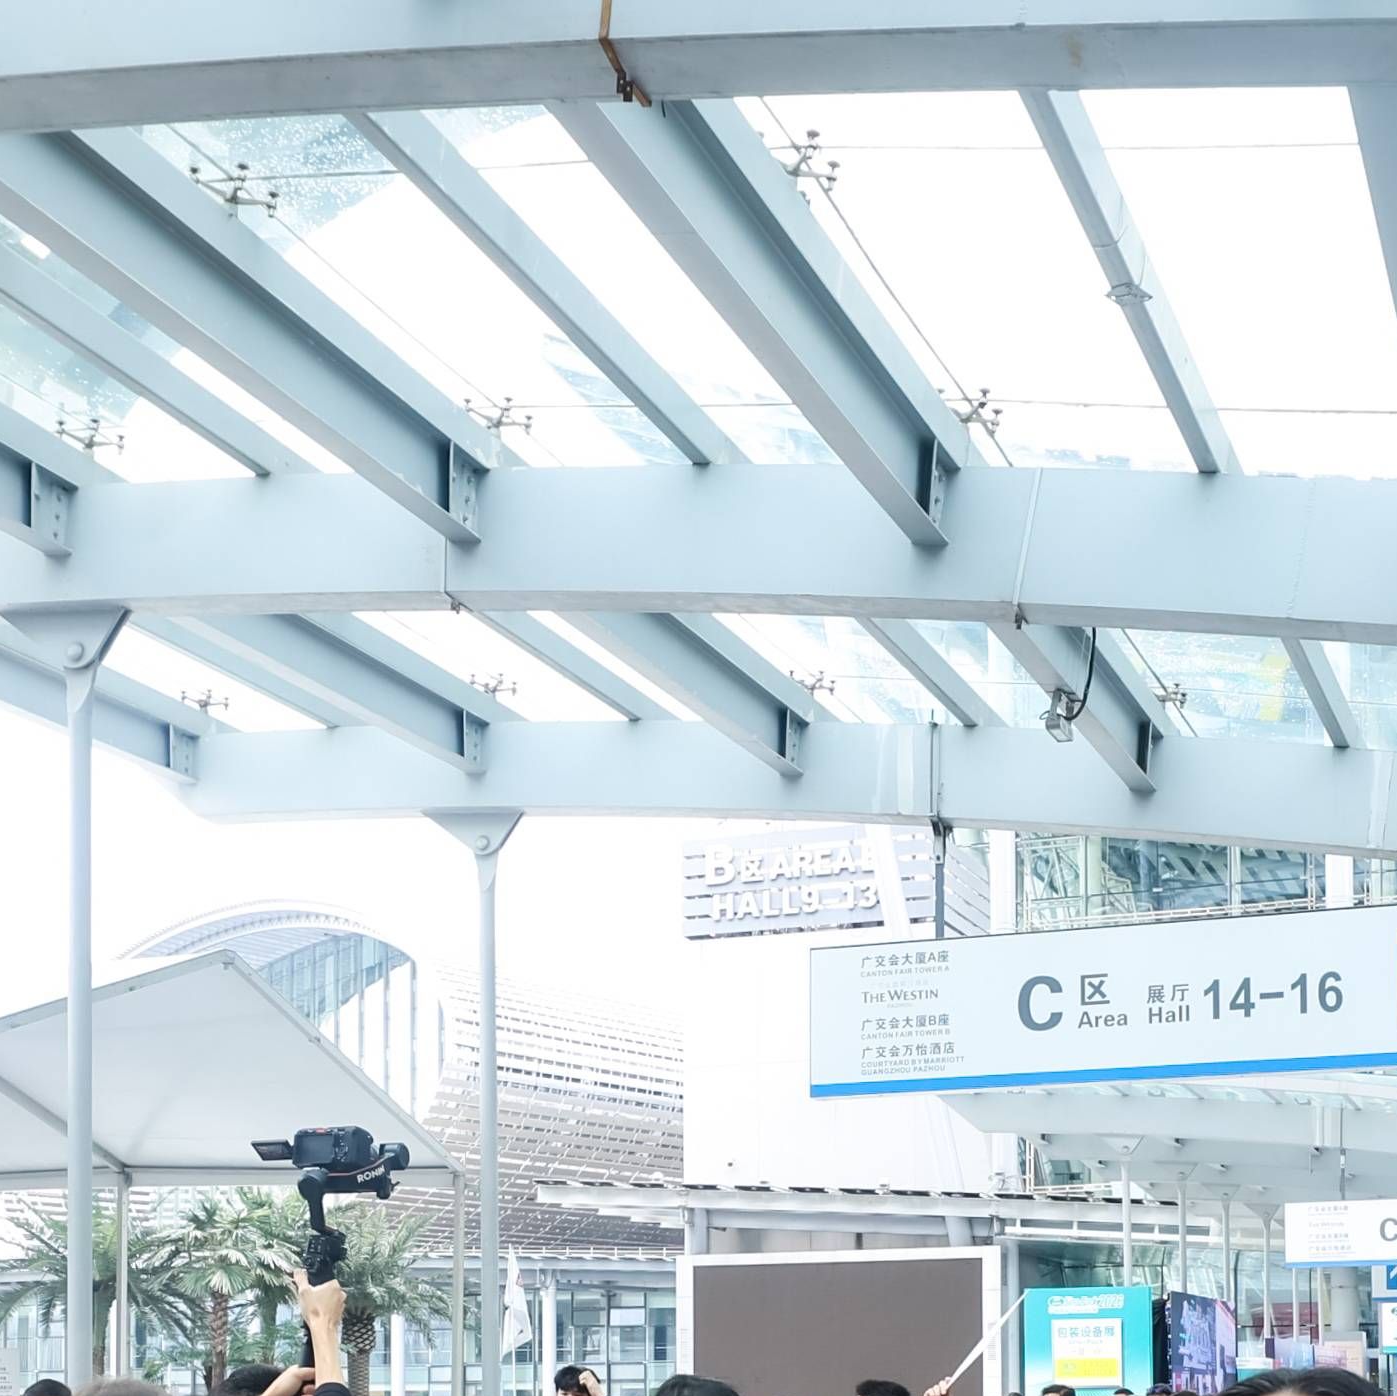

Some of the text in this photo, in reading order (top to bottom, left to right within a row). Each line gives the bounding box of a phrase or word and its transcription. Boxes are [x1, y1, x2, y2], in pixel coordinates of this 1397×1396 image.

[711, 885, 800, 921] HALL
[861, 950, 949, 968] 广交会大厦A座
[1080, 973, 1111, 1006] 区
[1146, 983, 1190, 1005] 展厅
[1203, 971, 1344, 1020] 14-16
[1017, 975, 1063, 1032] C
[861, 1013, 950, 1031] 广交会大厦B座
[1077, 1010, 1129, 1029] Area
[1147, 1004, 1191, 1024] Hall
[861, 1041, 955, 1060] 广交会万怡酒店
[356, 1164, 385, 1183] RONIN
